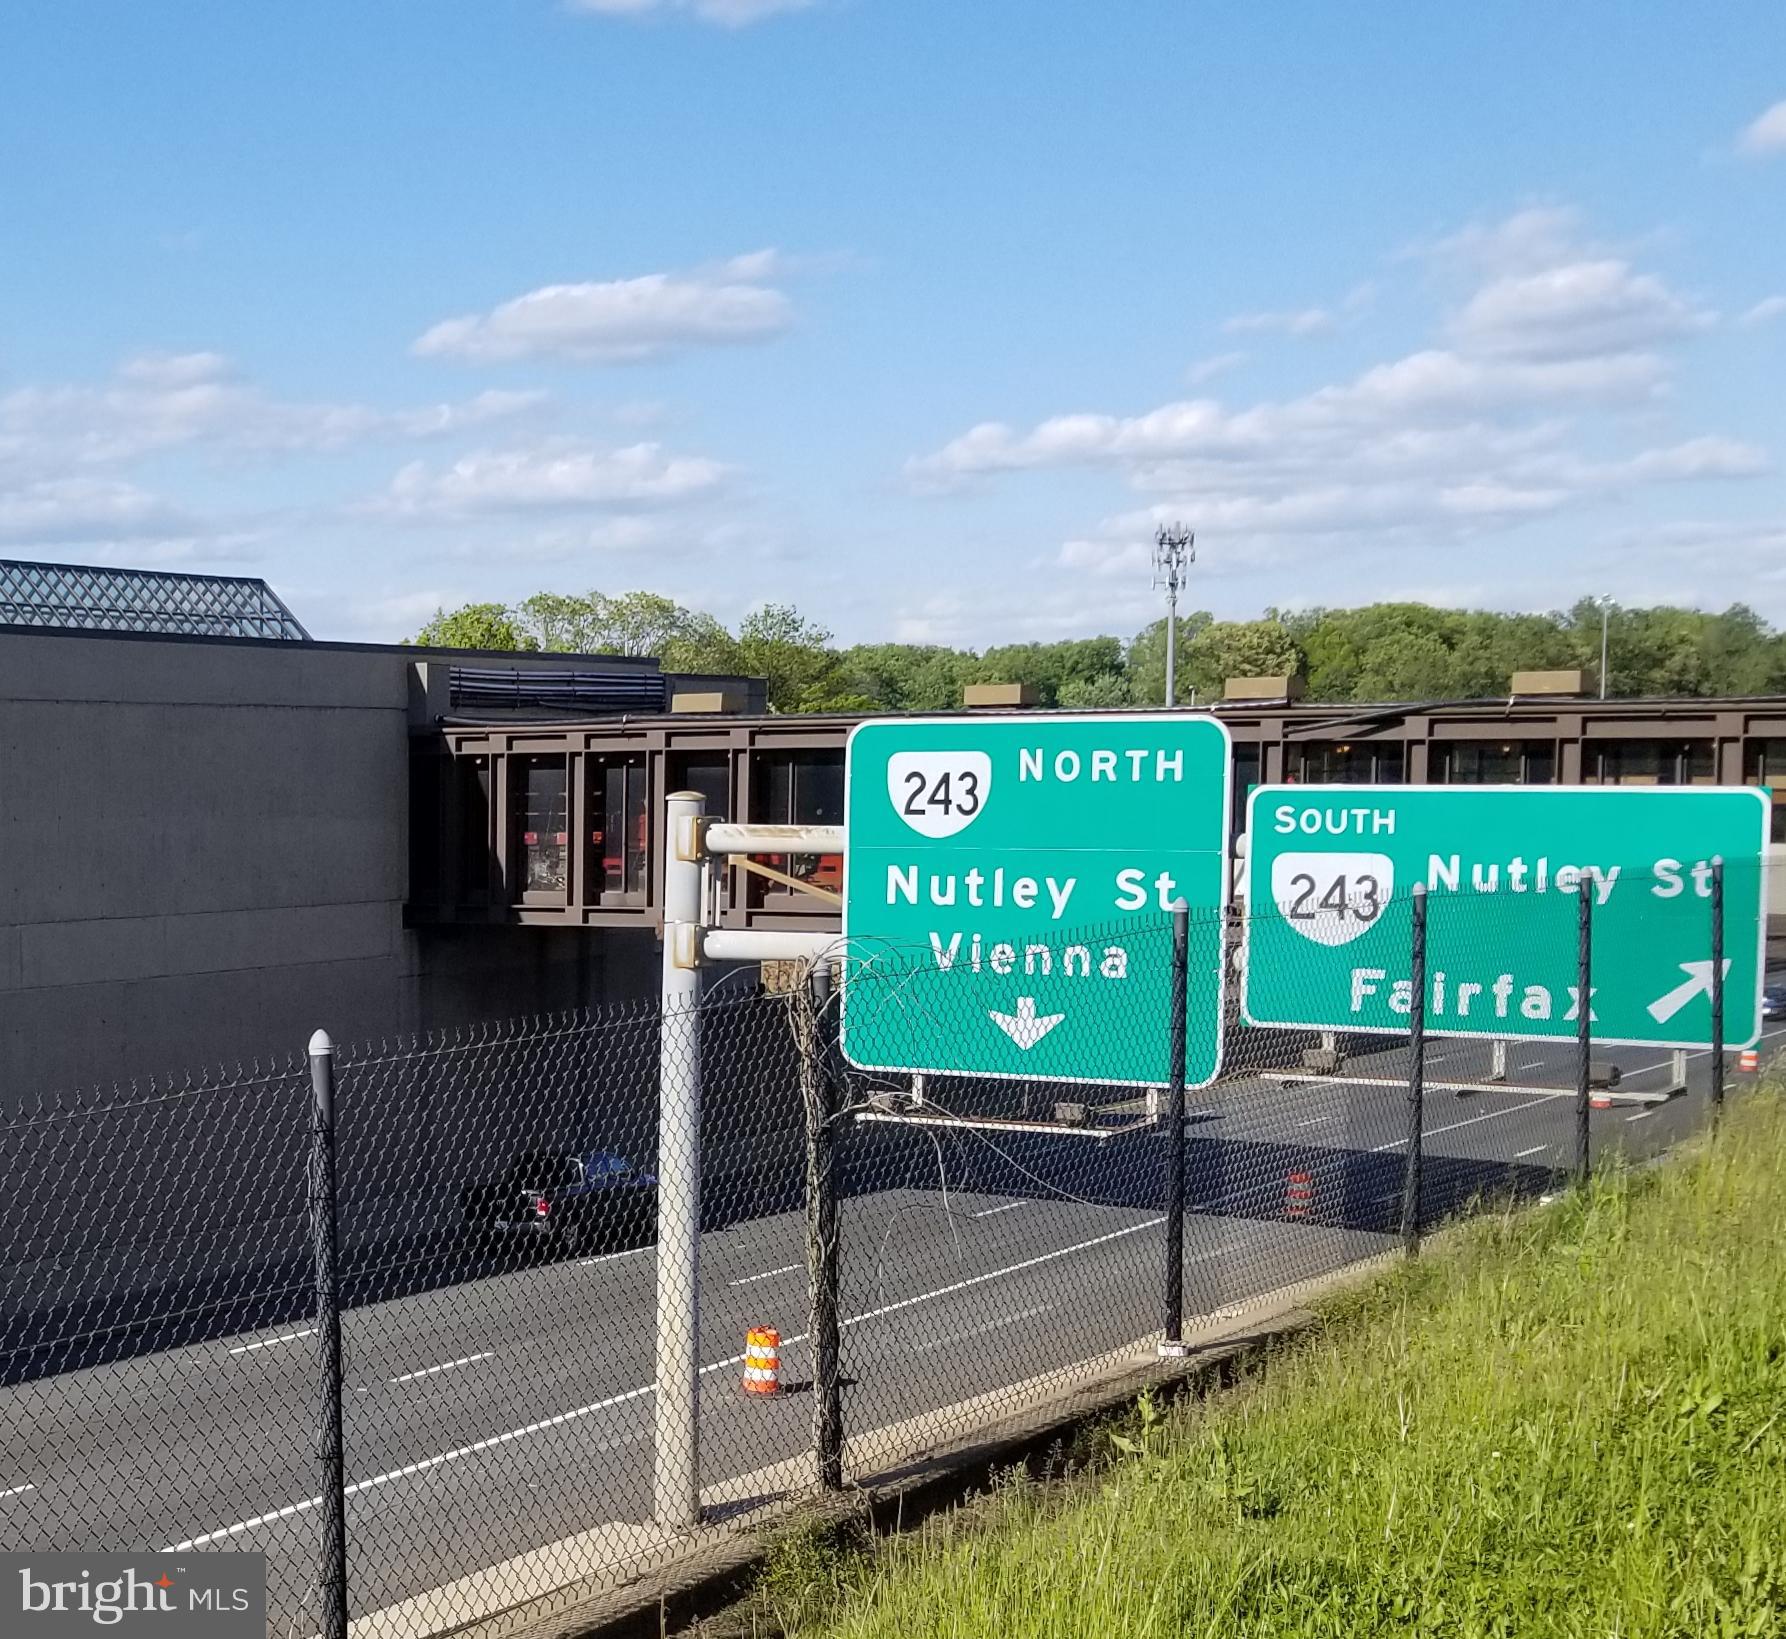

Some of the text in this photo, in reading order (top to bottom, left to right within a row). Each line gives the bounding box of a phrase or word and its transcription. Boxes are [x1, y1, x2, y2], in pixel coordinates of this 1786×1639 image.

[1019, 748, 1184, 783] NORTH
[904, 771, 979, 817] 243
[1273, 805, 1397, 835] SOUTH
[886, 864, 1178, 920] Nutley St
[1290, 872, 1380, 922] 243
[1650, 857, 1713, 899] St
[929, 932, 1128, 979] Vienna
